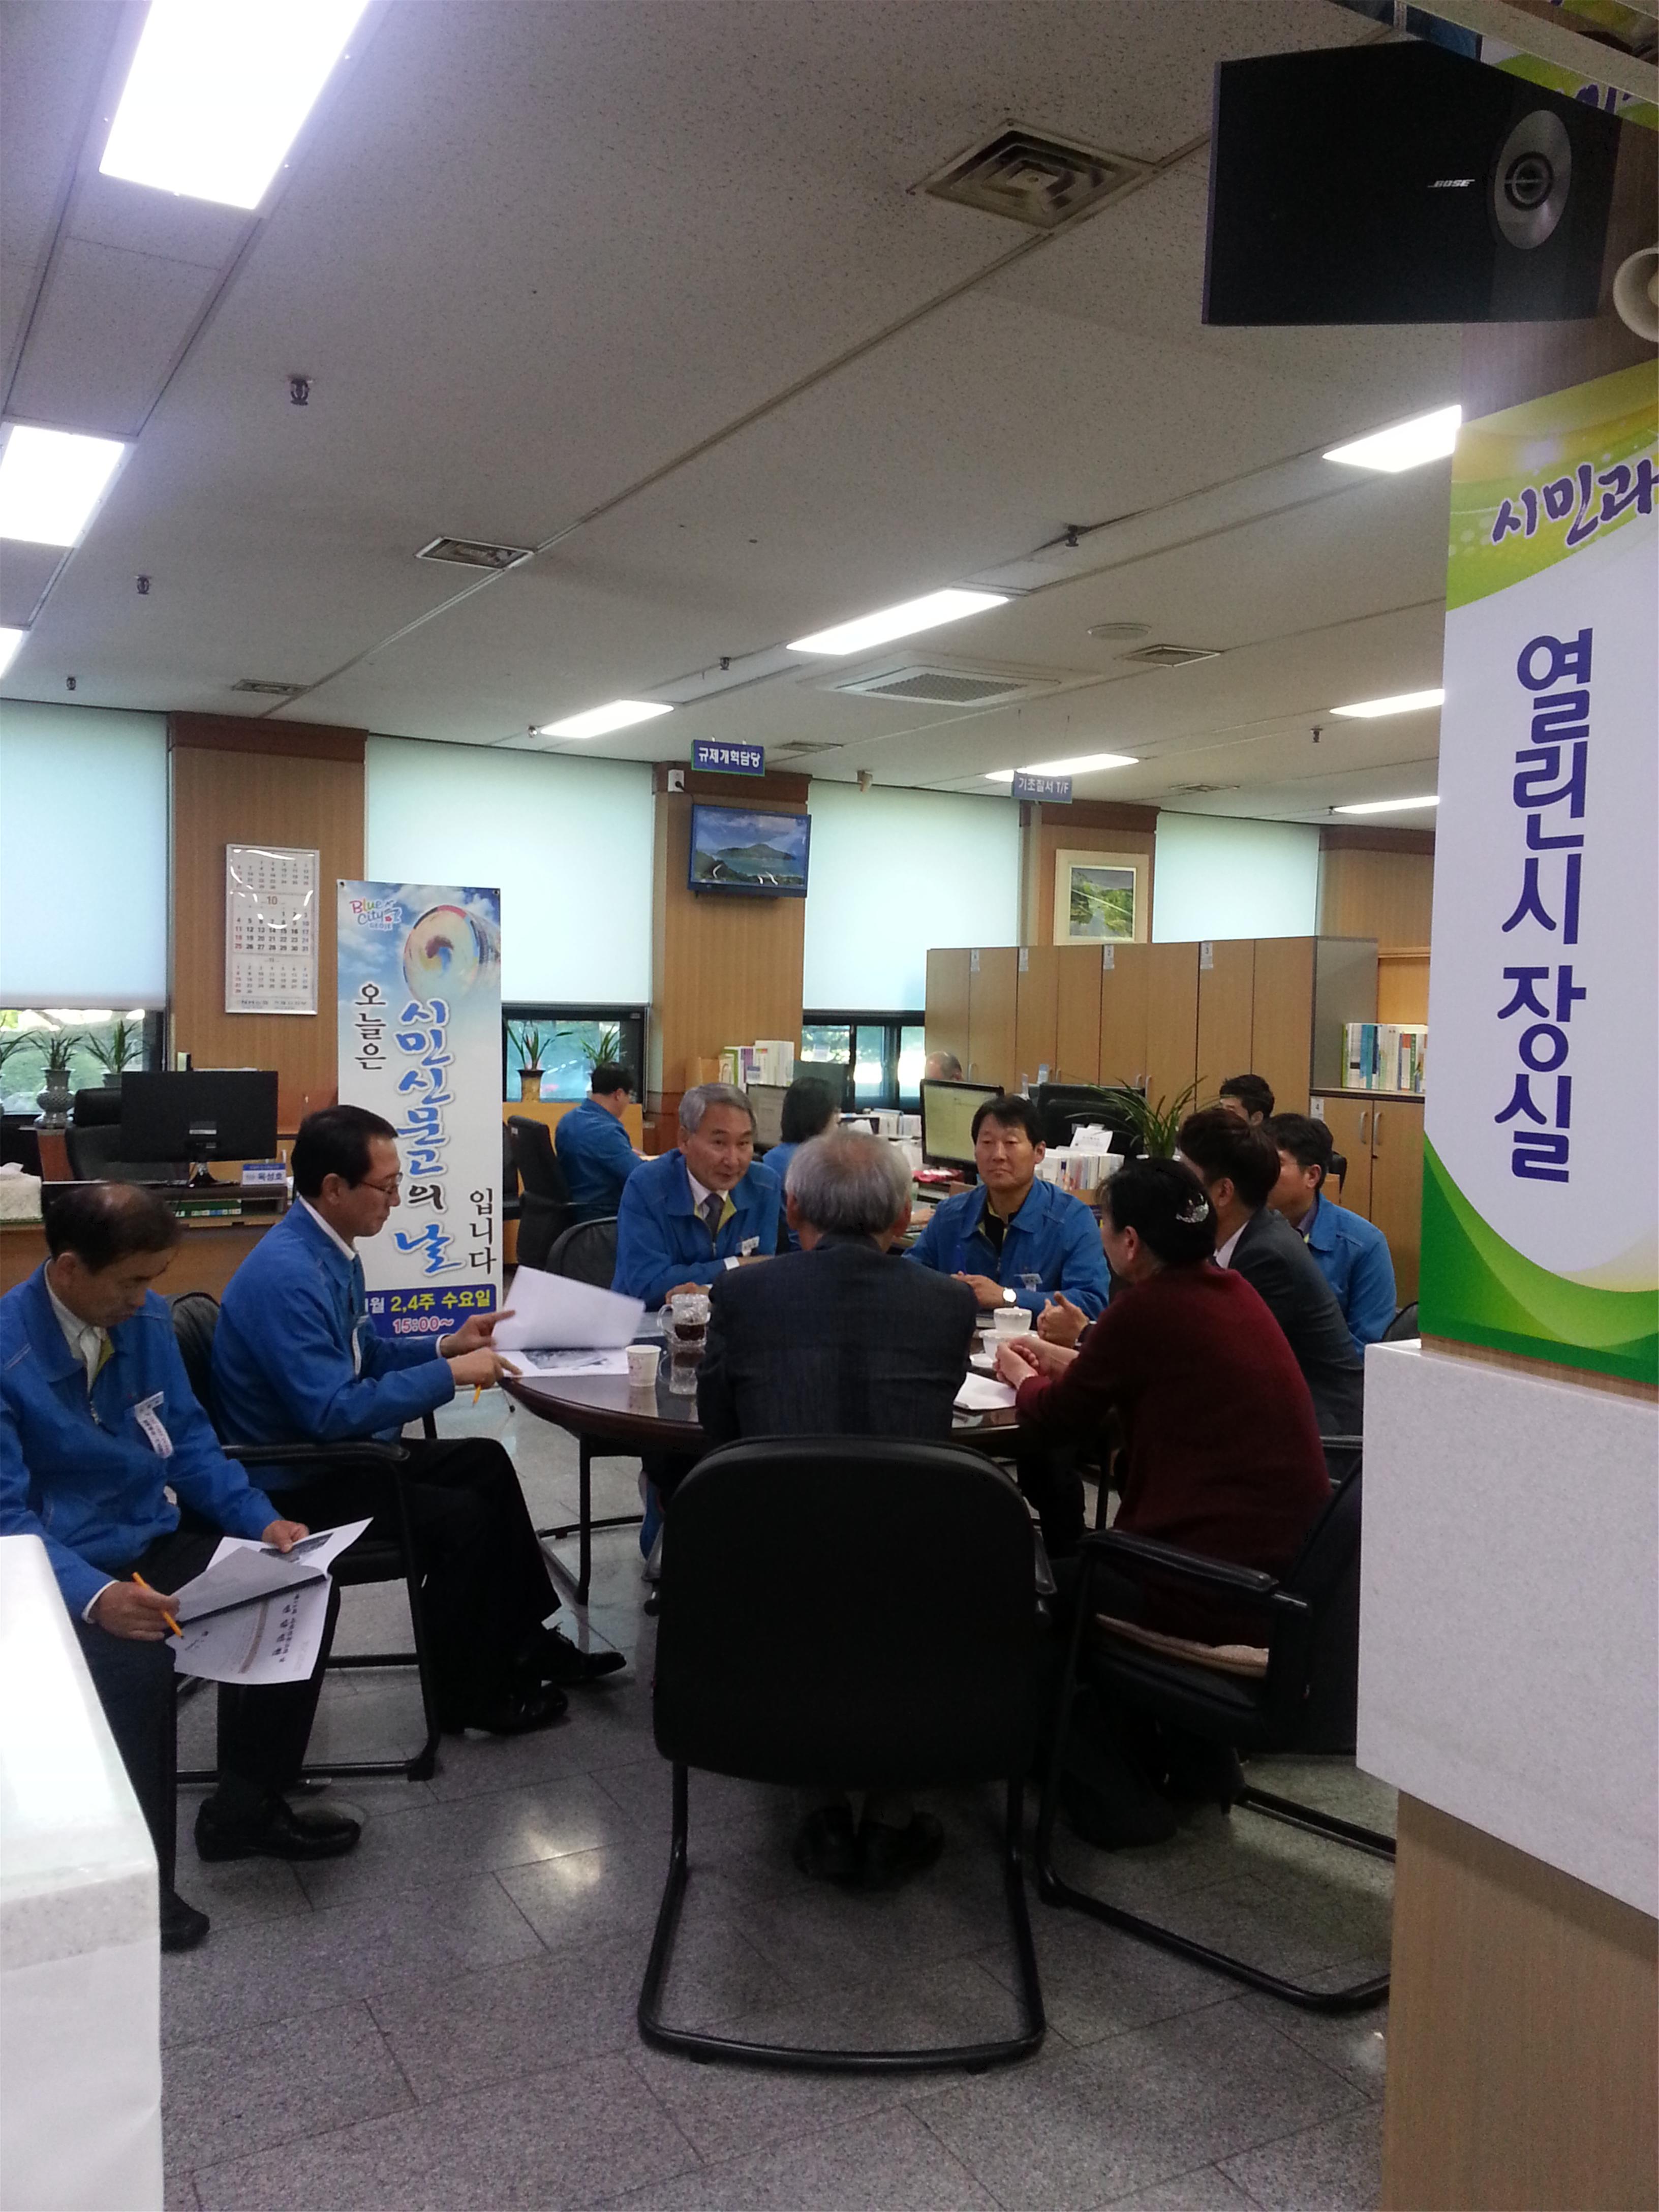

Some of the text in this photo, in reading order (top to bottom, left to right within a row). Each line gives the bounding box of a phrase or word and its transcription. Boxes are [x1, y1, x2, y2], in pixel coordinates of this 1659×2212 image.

[1428, 179, 1475, 188] BOSE
[1492, 458, 1659, 546] 시민과
[698, 747, 761, 768] 규제개혁담당
[1019, 778, 1069, 794] 기초질서 T/F
[267, 896, 277, 905] 10
[349, 898, 383, 913] Blue
[358, 910, 384, 925] City
[355, 984, 387, 1070] 오늘은
[394, 1000, 462, 1274] 시민신문고의 날
[469, 1188, 497, 1275] 입니다
[365, 1289, 490, 1314] 월 2,4주 수요일
[393, 1316, 454, 1334] 15:00~
